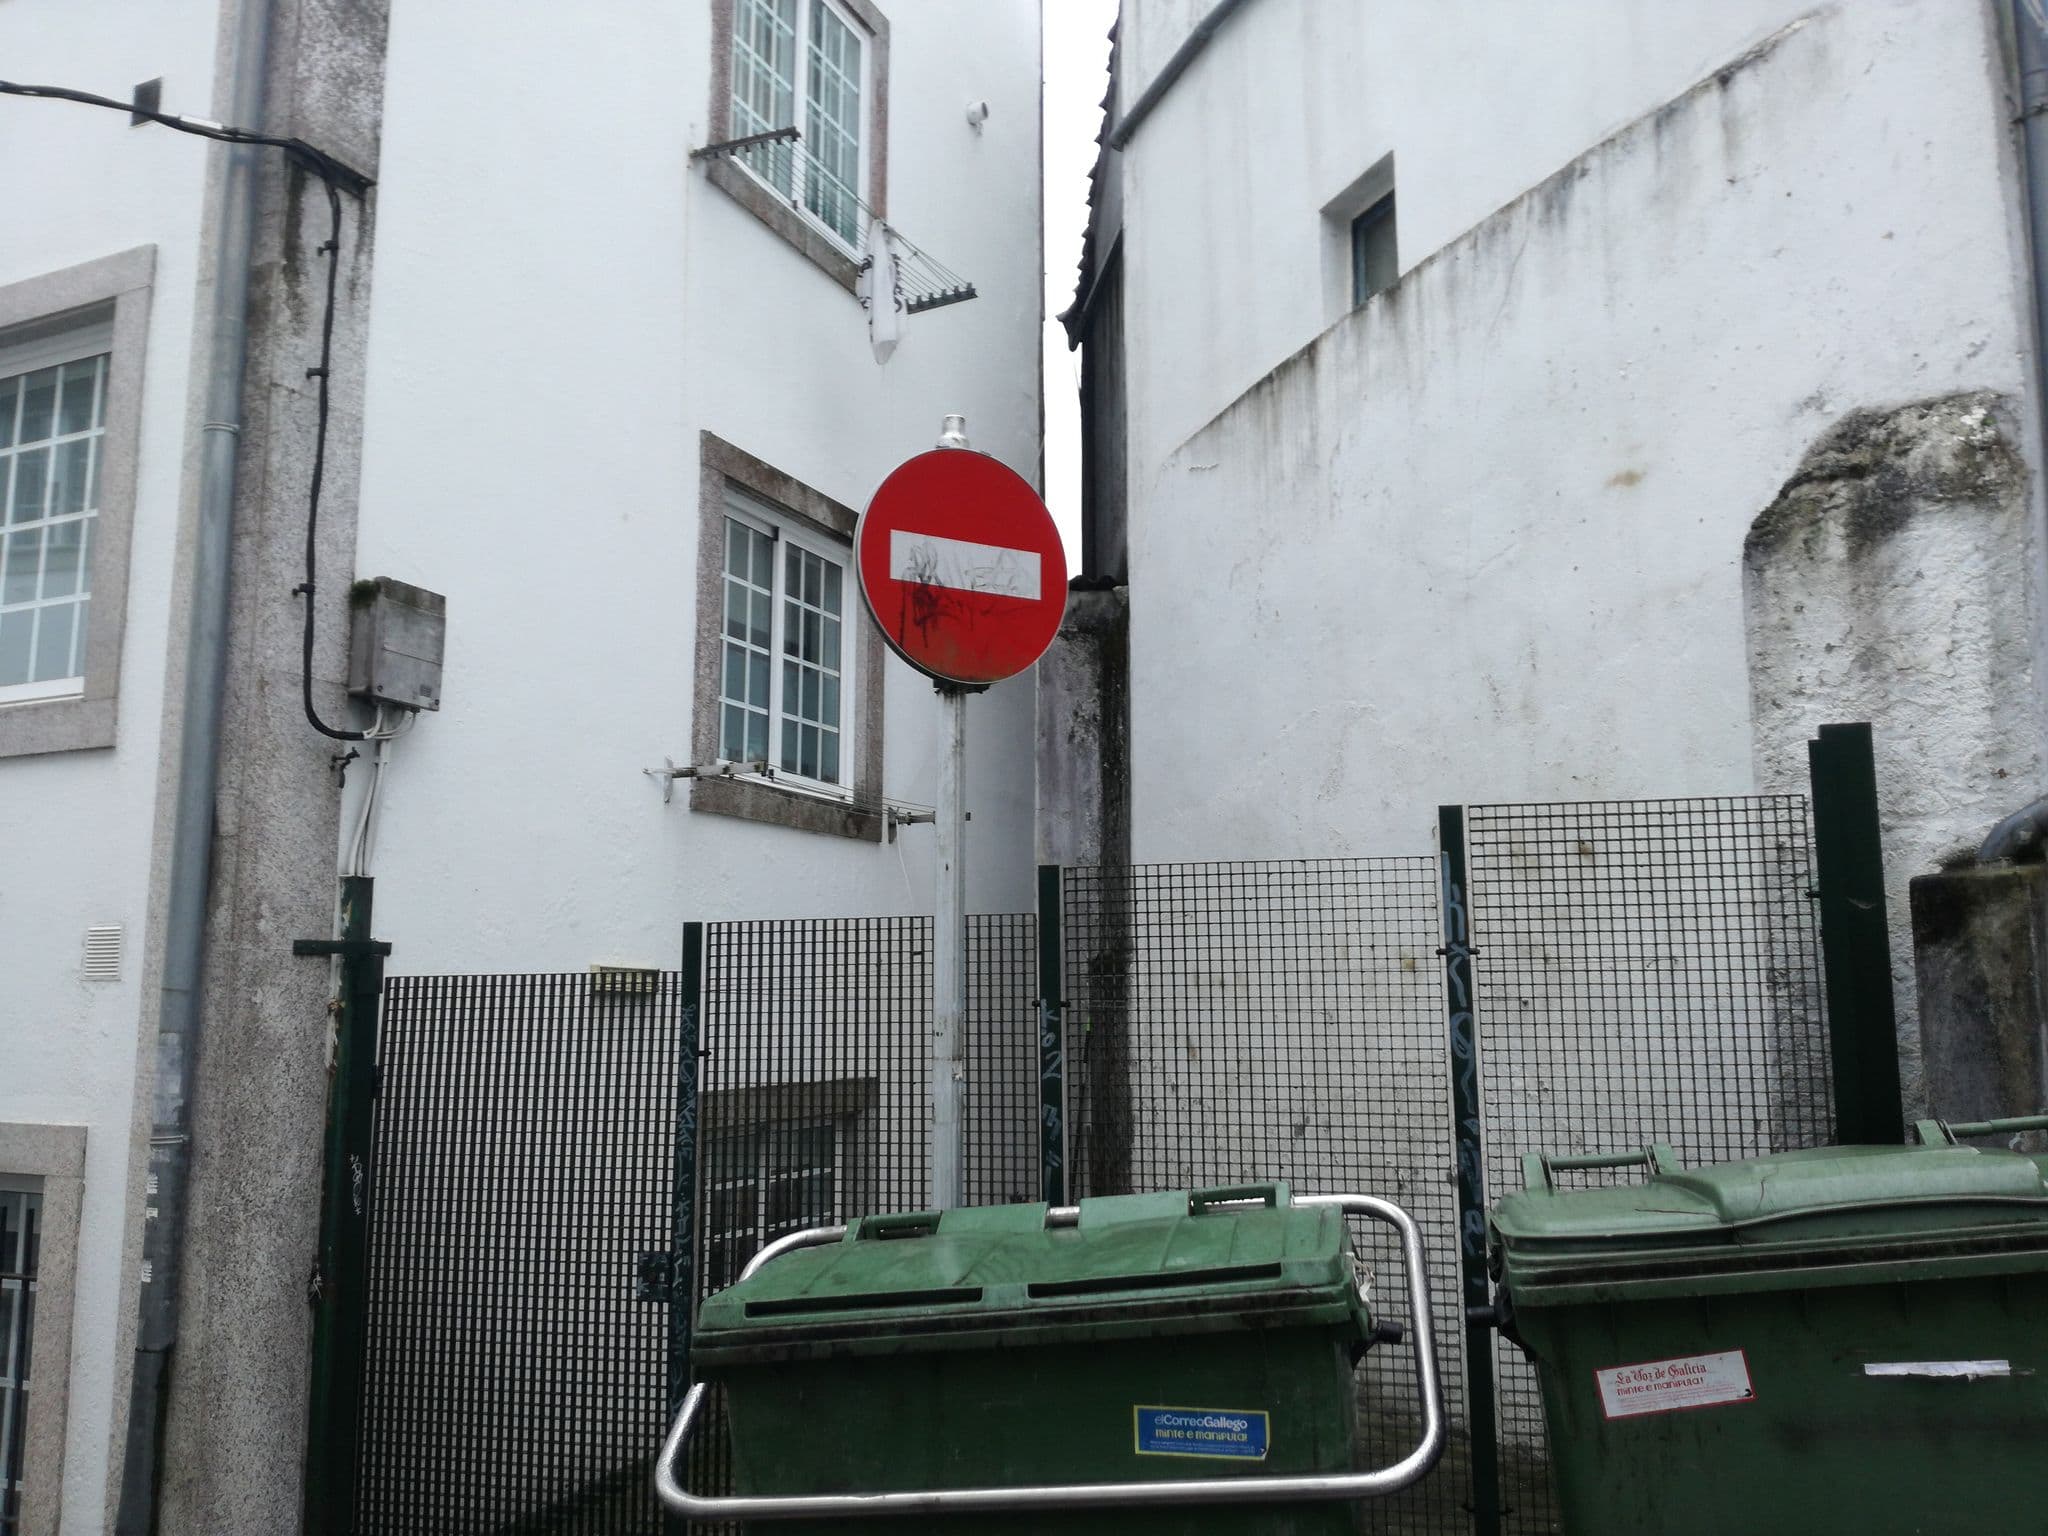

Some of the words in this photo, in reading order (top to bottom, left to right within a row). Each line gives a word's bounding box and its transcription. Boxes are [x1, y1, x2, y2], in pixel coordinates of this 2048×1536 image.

[1616, 1372, 1631, 1385] La
[1655, 1367, 1665, 1379] de
[1668, 1363, 1707, 1379] Galicia
[1155, 1428, 1185, 1439] minte
[1186, 1430, 1194, 1439] e
